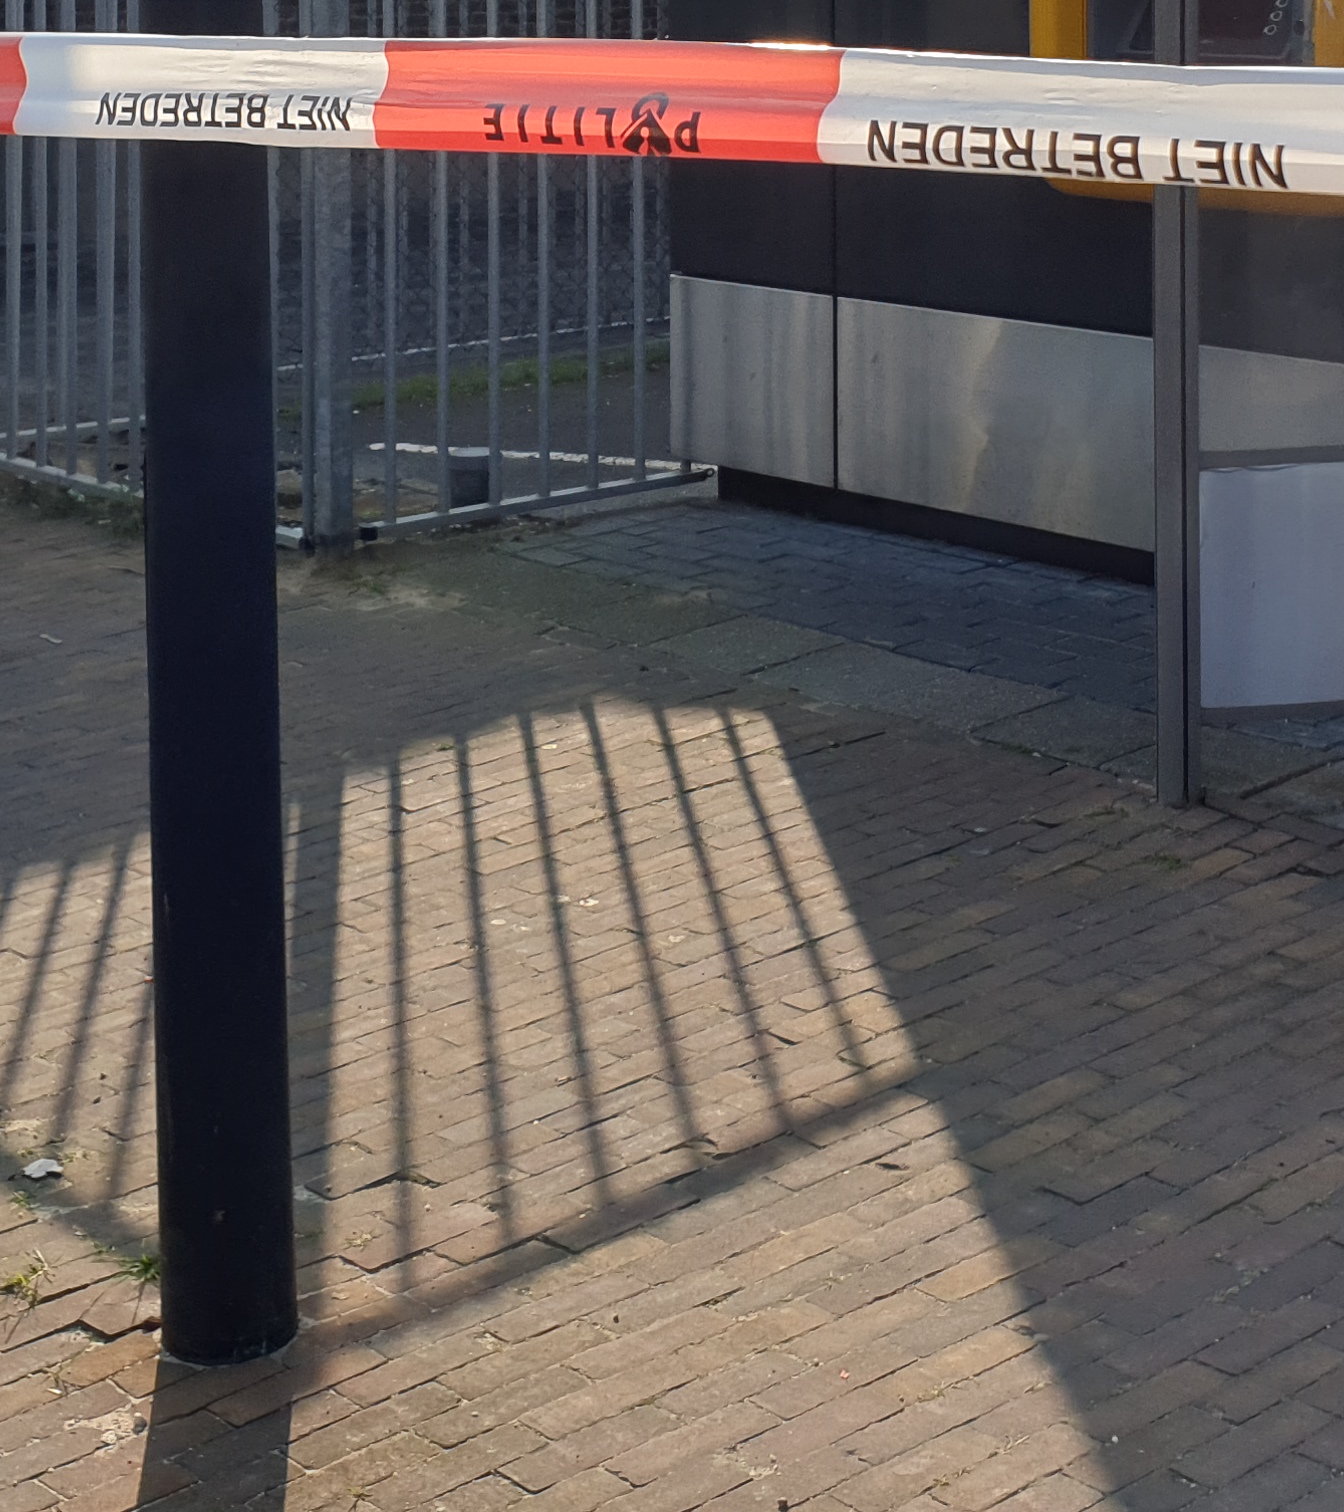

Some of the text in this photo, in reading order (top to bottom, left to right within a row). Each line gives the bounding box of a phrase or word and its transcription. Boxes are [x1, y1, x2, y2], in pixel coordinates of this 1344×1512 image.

[94, 91, 354, 132] NIET BETREDEN
[867, 119, 1289, 189] NIET BETREDEN
